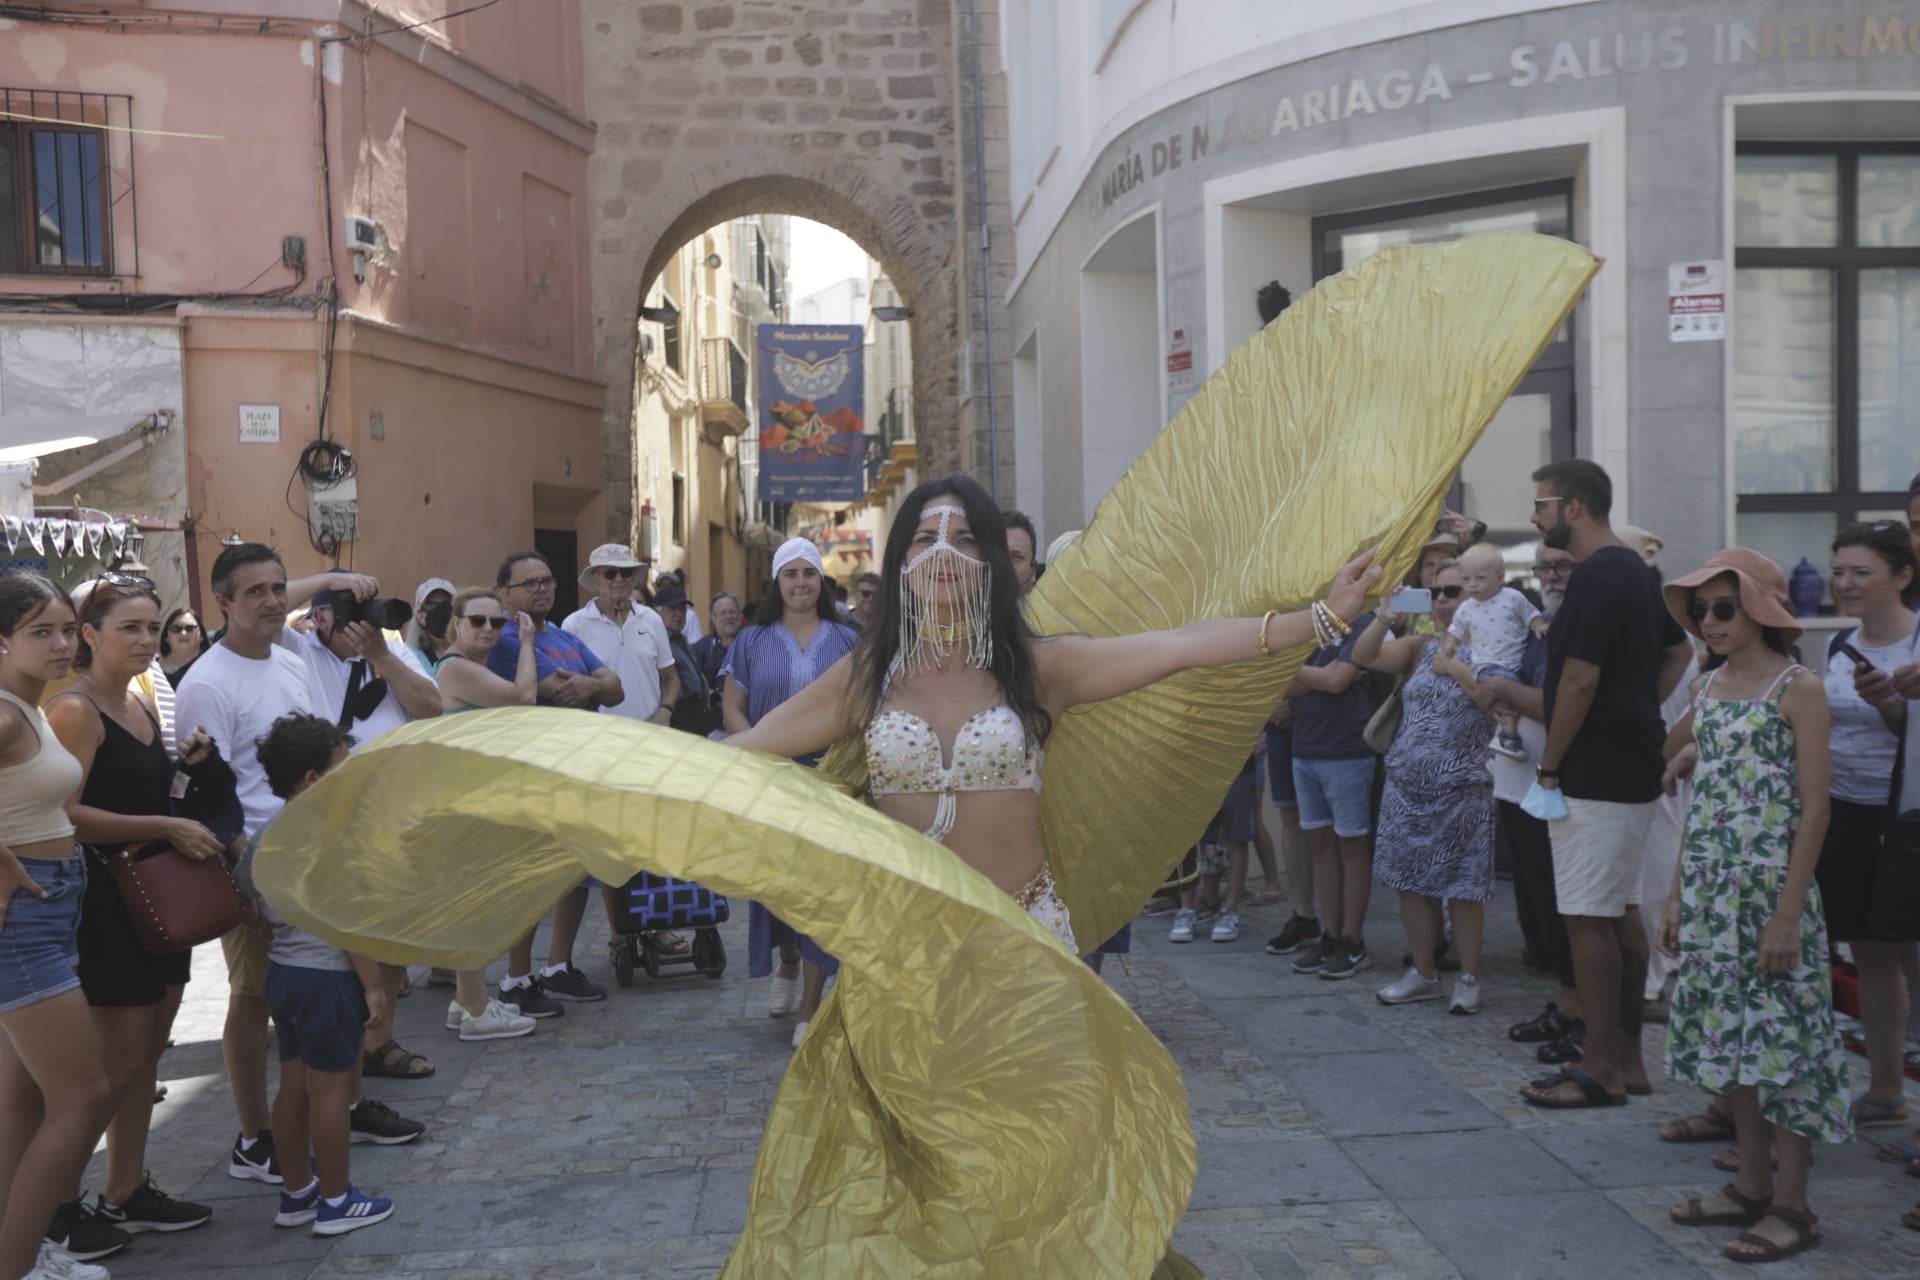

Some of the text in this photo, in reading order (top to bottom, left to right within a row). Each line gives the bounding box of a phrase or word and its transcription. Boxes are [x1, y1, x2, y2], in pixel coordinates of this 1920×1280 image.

[1102, 147, 1145, 208] MARÍA
[1151, 134, 1182, 177] DE
[1191, 63, 1453, 162] MADARIAGA
[1509, 27, 1690, 88] SALUS
[246, 412, 272, 421] PLAZA
[240, 428, 277, 437] CATEDRAL
